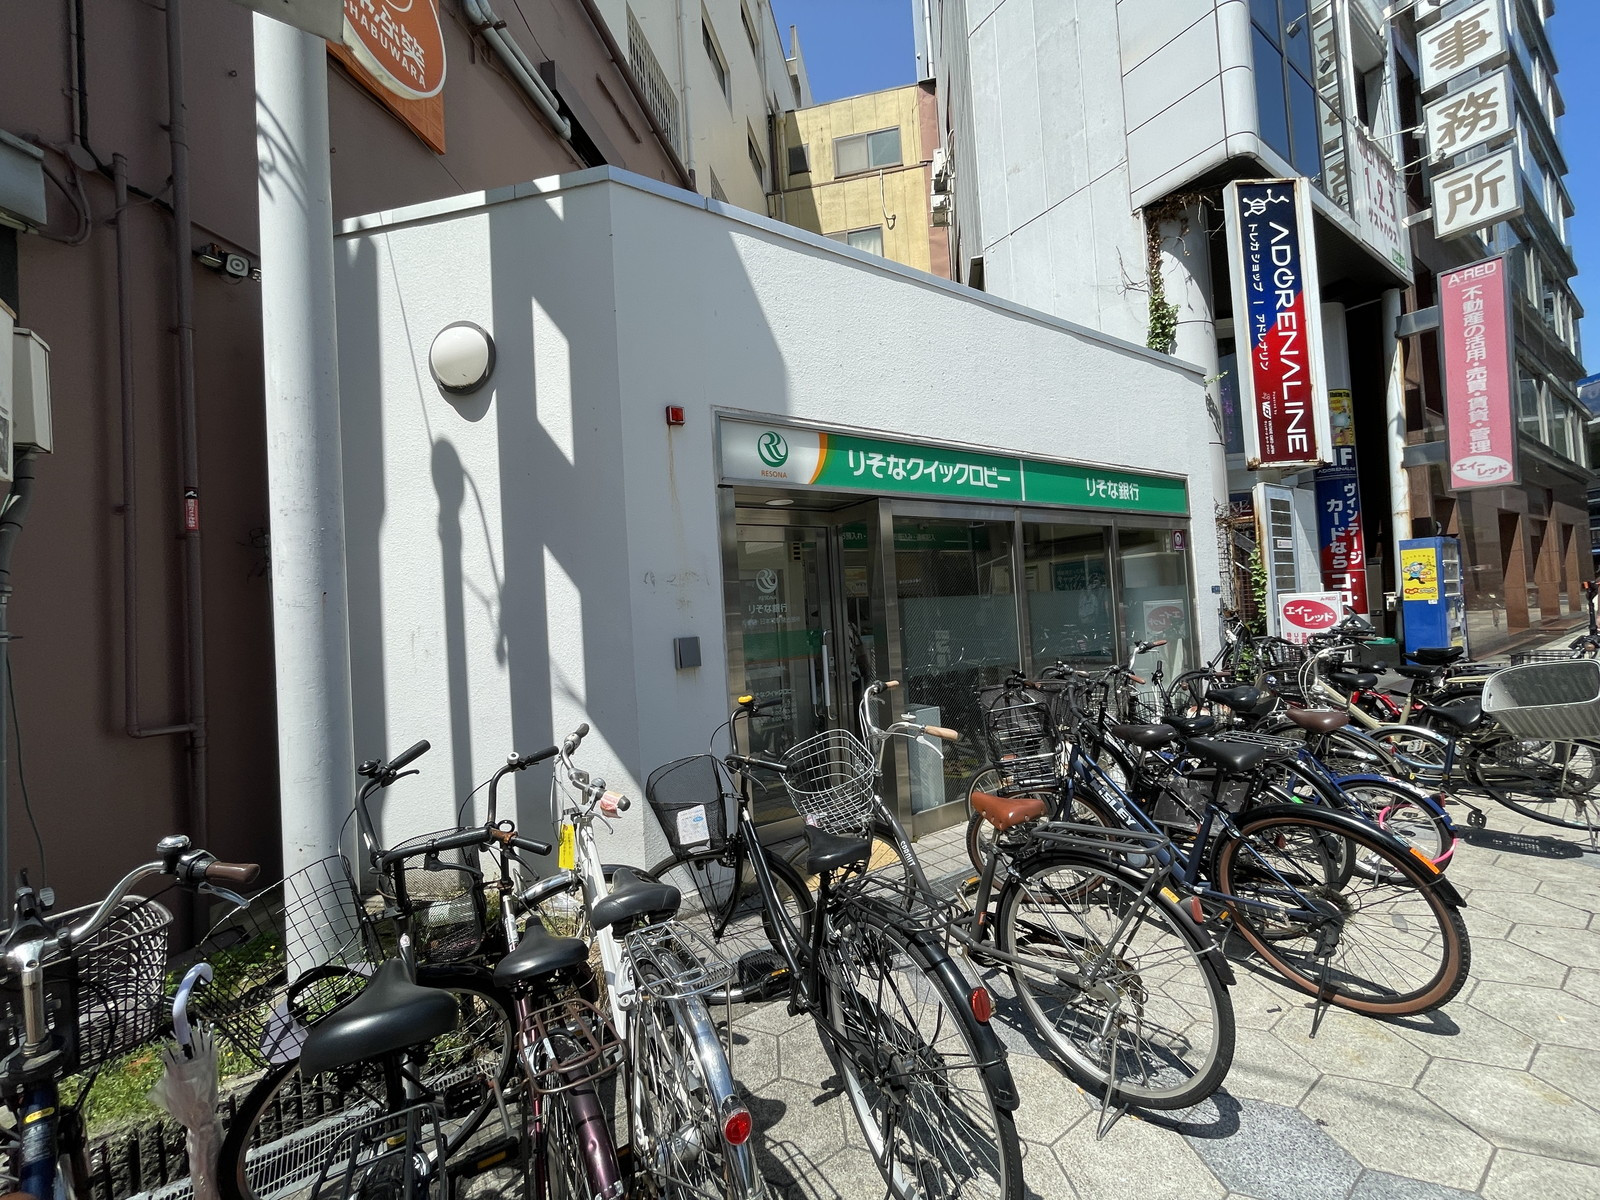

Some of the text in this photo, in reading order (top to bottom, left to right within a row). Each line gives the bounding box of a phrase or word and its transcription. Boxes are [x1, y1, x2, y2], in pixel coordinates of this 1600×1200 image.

[1427, 8, 1506, 225] 事務所
[1447, 262, 1497, 286] A-RED
[1255, 314, 1270, 371] アドレナリン
[1269, 222, 1308, 453] ADORENALINE
[761, 469, 788, 479] RESONA
[848, 449, 1011, 489] りそなクイックロビー
[1477, 463, 1508, 477] レッド
[1086, 477, 1140, 501] りそな銀行
[1344, 483, 1363, 566] ヴィンテージ
[748, 603, 788, 614] りそな銀行
[1285, 606, 1313, 615] エイー
[1304, 612, 1334, 623] レッド
